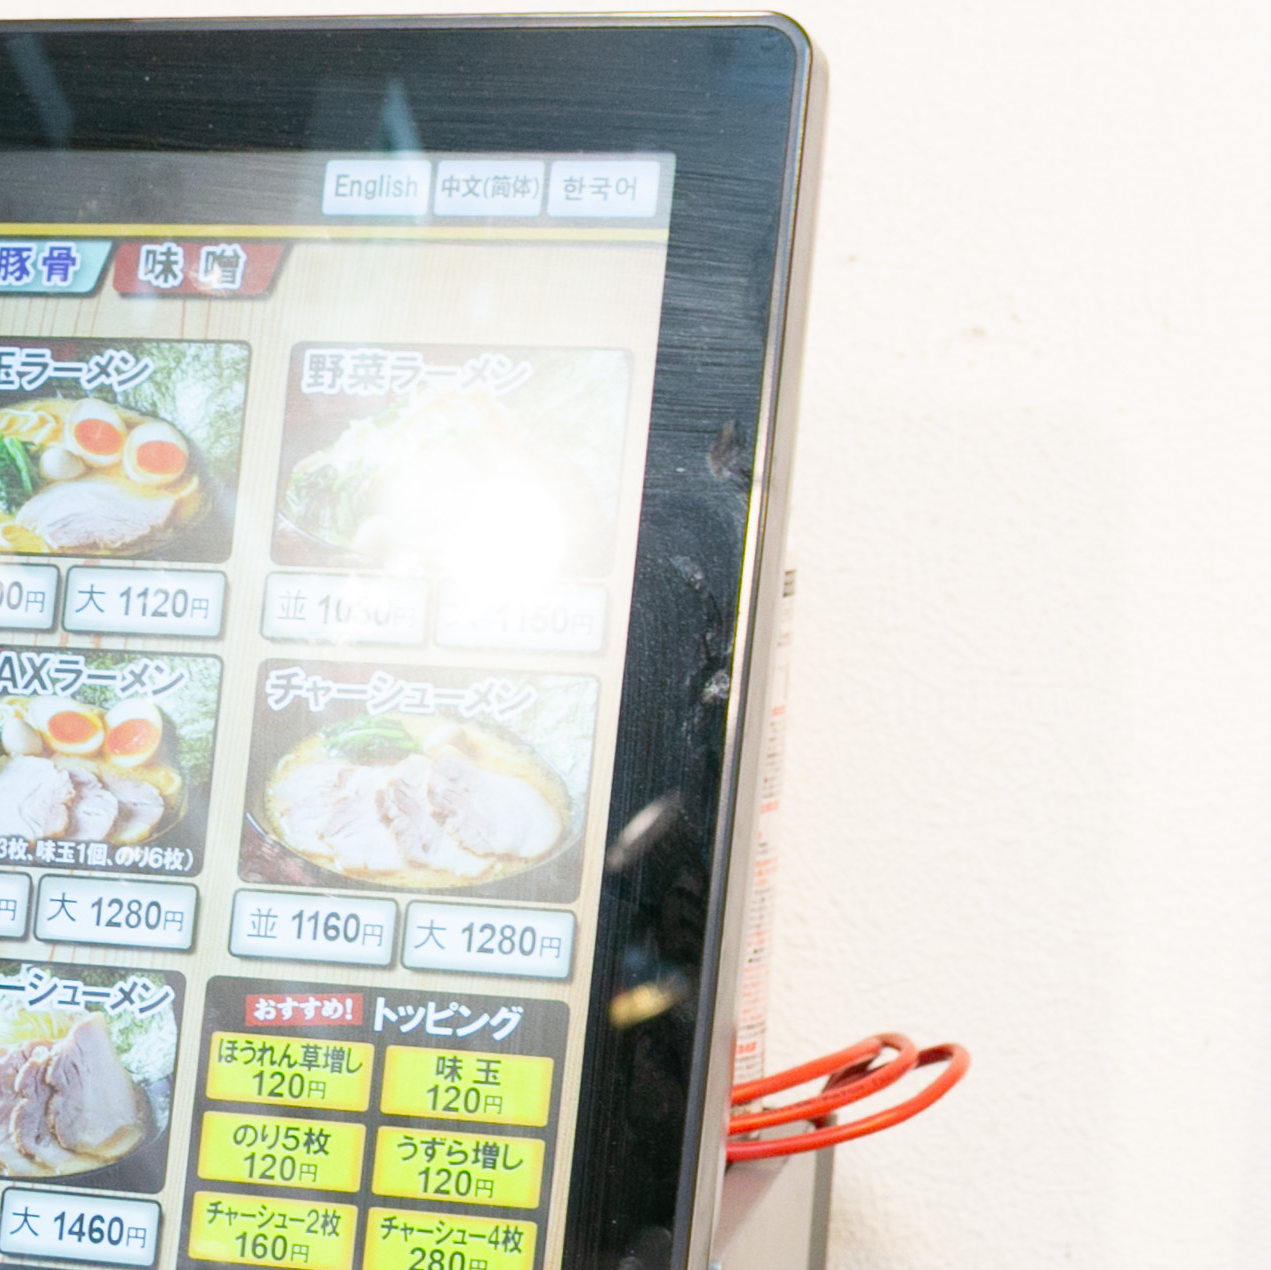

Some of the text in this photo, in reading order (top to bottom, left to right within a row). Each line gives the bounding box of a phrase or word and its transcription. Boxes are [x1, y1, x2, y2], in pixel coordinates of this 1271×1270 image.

[334, 173, 419, 201] English
[563, 175, 638, 201] 한국어
[302, 348, 531, 395] 野菜ラーメン
[265, 666, 538, 719] チャーシューメン
[374, 997, 523, 1041] トッピング
[217, 1038, 363, 1074] ほうれん草増し
[436, 1055, 502, 1087] 味玉
[252, 1070, 327, 1100] 120円
[426, 1085, 503, 1115] 120円
[232, 1123, 331, 1156] のり5枚
[397, 1135, 523, 1171] うずら増し
[243, 1153, 318, 1183] 120円
[417, 1166, 494, 1199] 120円
[206, 1200, 341, 1238] チャーシュー2枚
[380, 1215, 524, 1254] チャーシュー4枚
[235, 1232, 309, 1263] 160円
